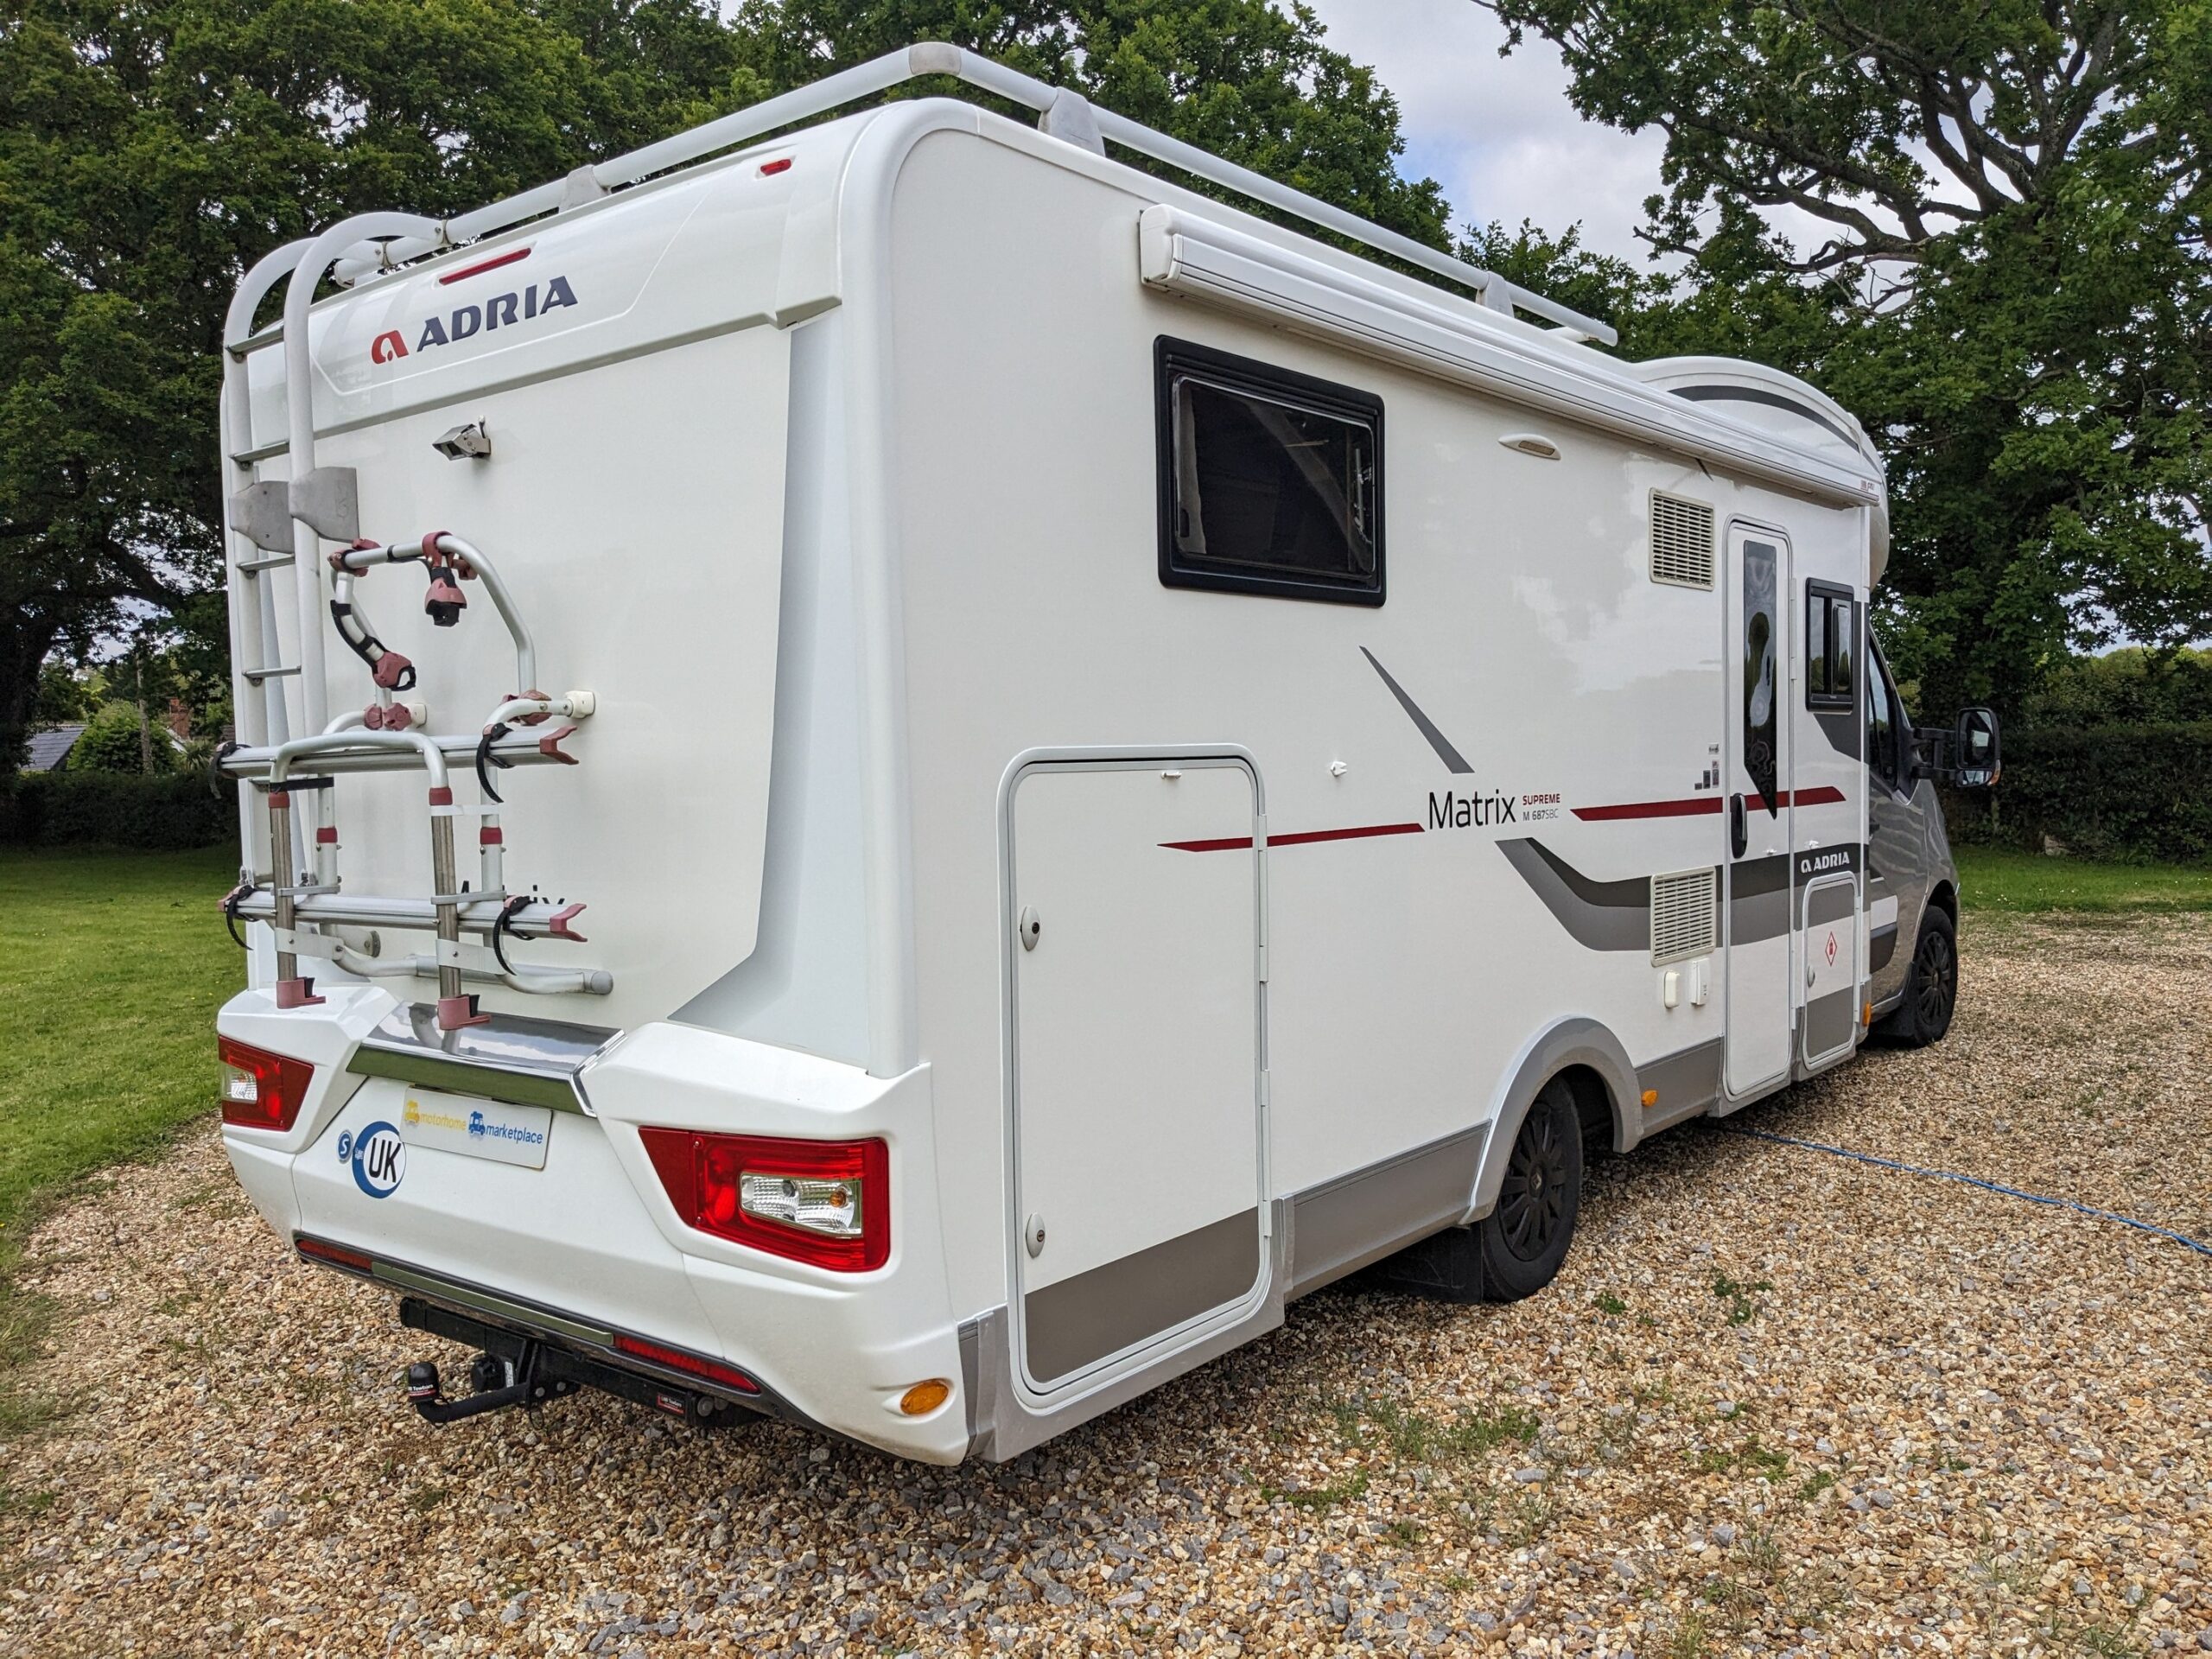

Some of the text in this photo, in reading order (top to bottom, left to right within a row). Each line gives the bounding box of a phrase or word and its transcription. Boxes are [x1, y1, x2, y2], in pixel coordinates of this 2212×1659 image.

[416, 276, 578, 353] ADRIA
[1429, 789, 1516, 830] Matrix
[1522, 793, 1560, 806] SUPREME
[1522, 808, 1559, 822] M 687SBC
[1814, 851, 1850, 872] ADRIA
[419, 1112, 543, 1144] motorhome marketplace
[368, 1137, 402, 1184] UK
